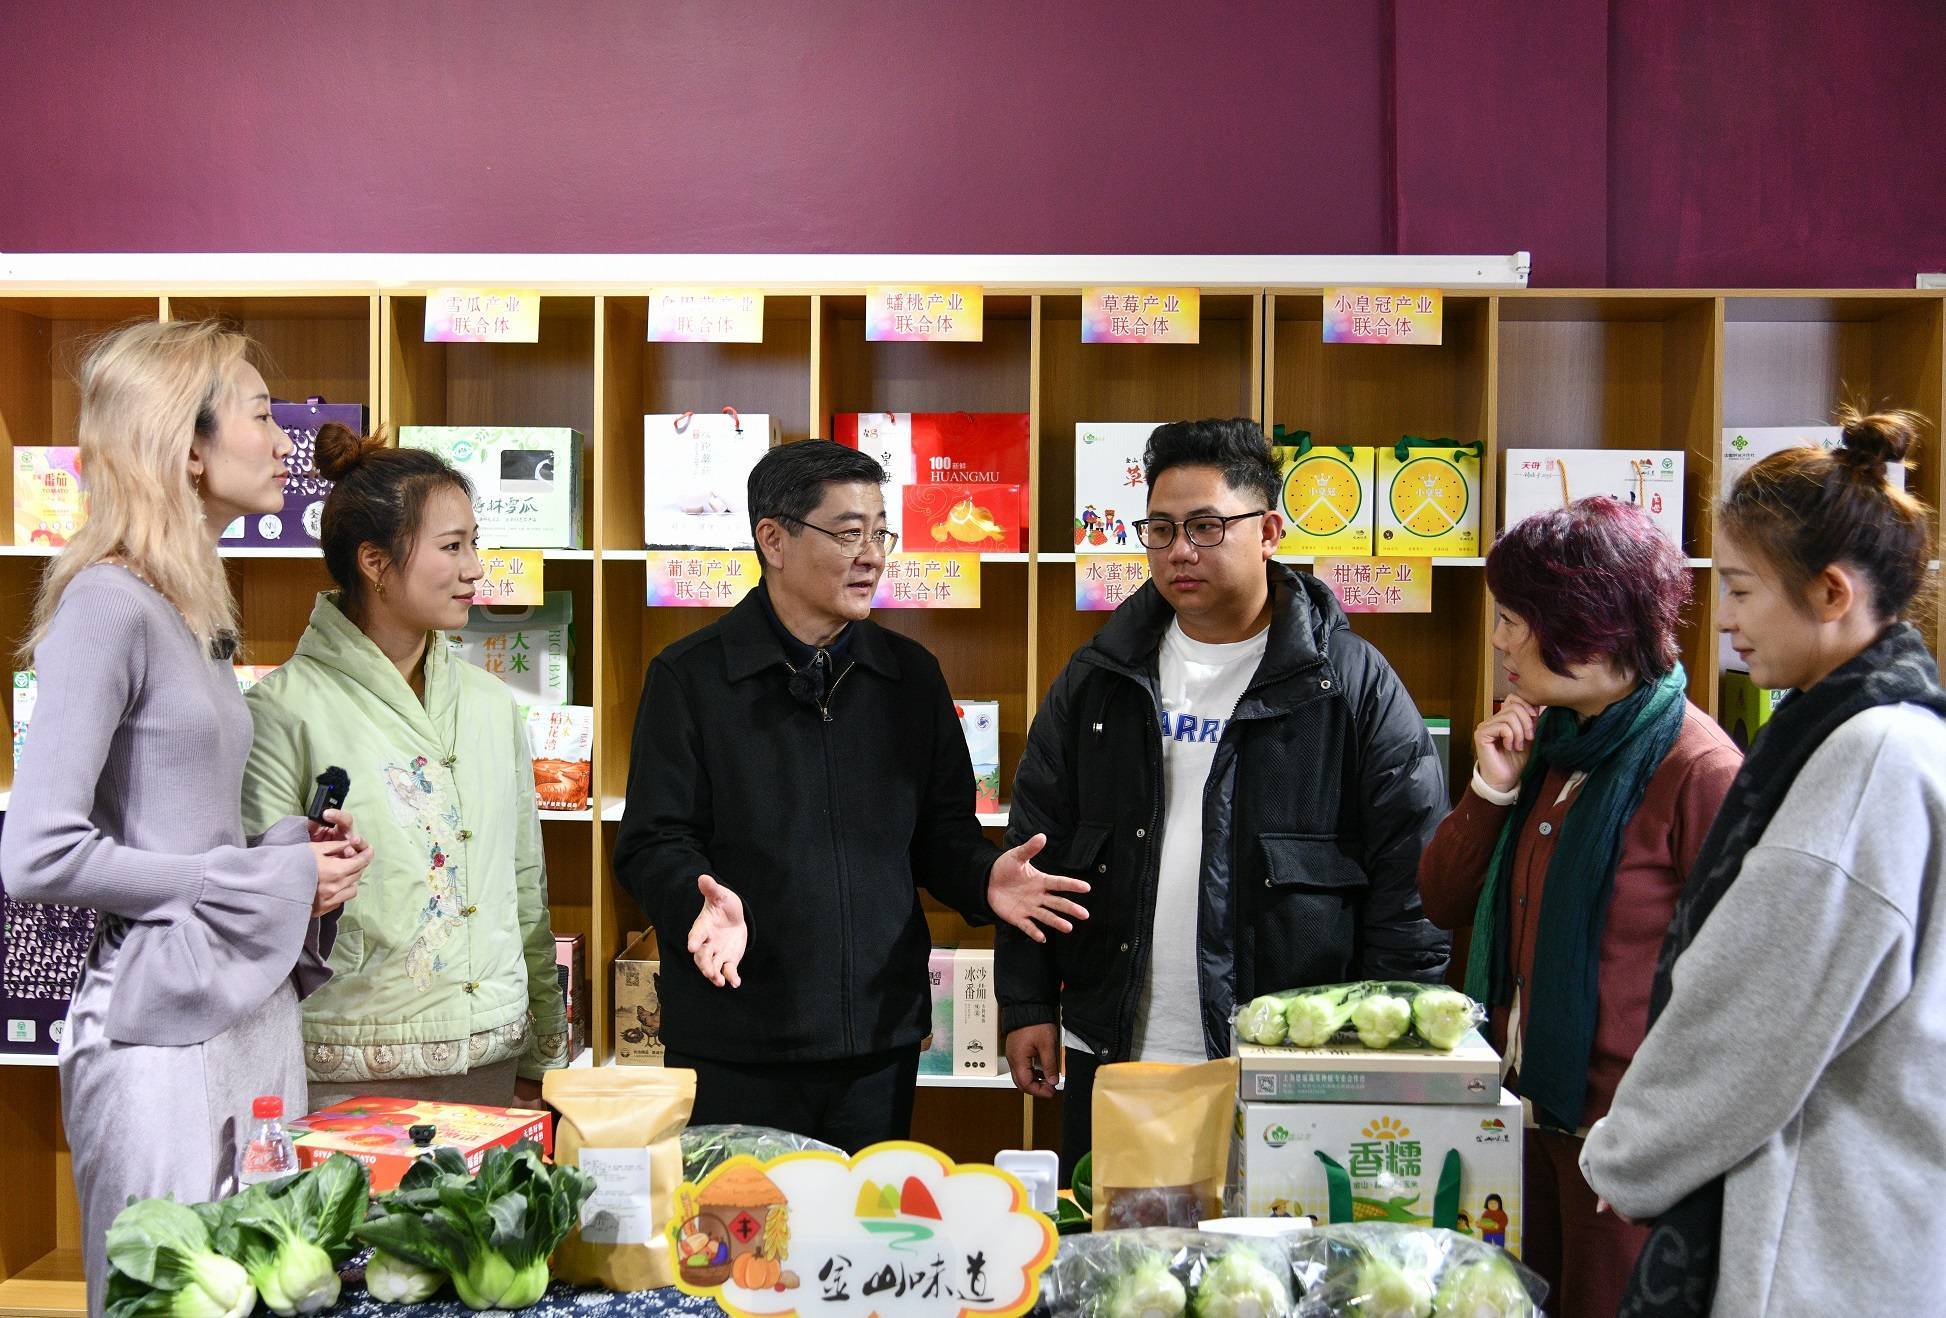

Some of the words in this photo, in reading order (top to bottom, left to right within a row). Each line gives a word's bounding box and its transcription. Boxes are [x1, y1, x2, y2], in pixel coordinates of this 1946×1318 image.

[446, 296, 520, 313] 雪瓜产业
[886, 293, 963, 311] 蟠桃产业
[1102, 294, 1180, 313] 草莓产业
[1334, 295, 1433, 314] 小皇冠产业
[454, 316, 510, 334] 联合体
[677, 316, 734, 334] 联合体
[895, 314, 953, 333] 联合体
[1111, 316, 1169, 335] 联合体
[1353, 317, 1412, 336] 联合体
[929, 456, 951, 470] 100
[44, 472, 67, 487] 番茄
[930, 471, 1000, 482] HUANGMU
[1122, 464, 1148, 488] 草
[478, 557, 524, 575] 产业
[667, 559, 742, 577] 葡萄产业
[885, 560, 961, 578] 番茄产业
[1333, 564, 1412, 583] 柑橘产业
[474, 579, 515, 597] 合体
[676, 580, 732, 598] 联合体
[894, 582, 951, 600] 联合体
[1343, 586, 1402, 604] 联合体
[483, 632, 507, 682] 稻花
[510, 632, 530, 674] 大米
[548, 664, 561, 689] BAY
[964, 966, 987, 982] 冰沙
[965, 983, 987, 1000] 番茄
[1348, 1140, 1422, 1178] 香糯
[736, 1217, 753, 1238] 丰
[817, 1251, 995, 1303] 金山味道
